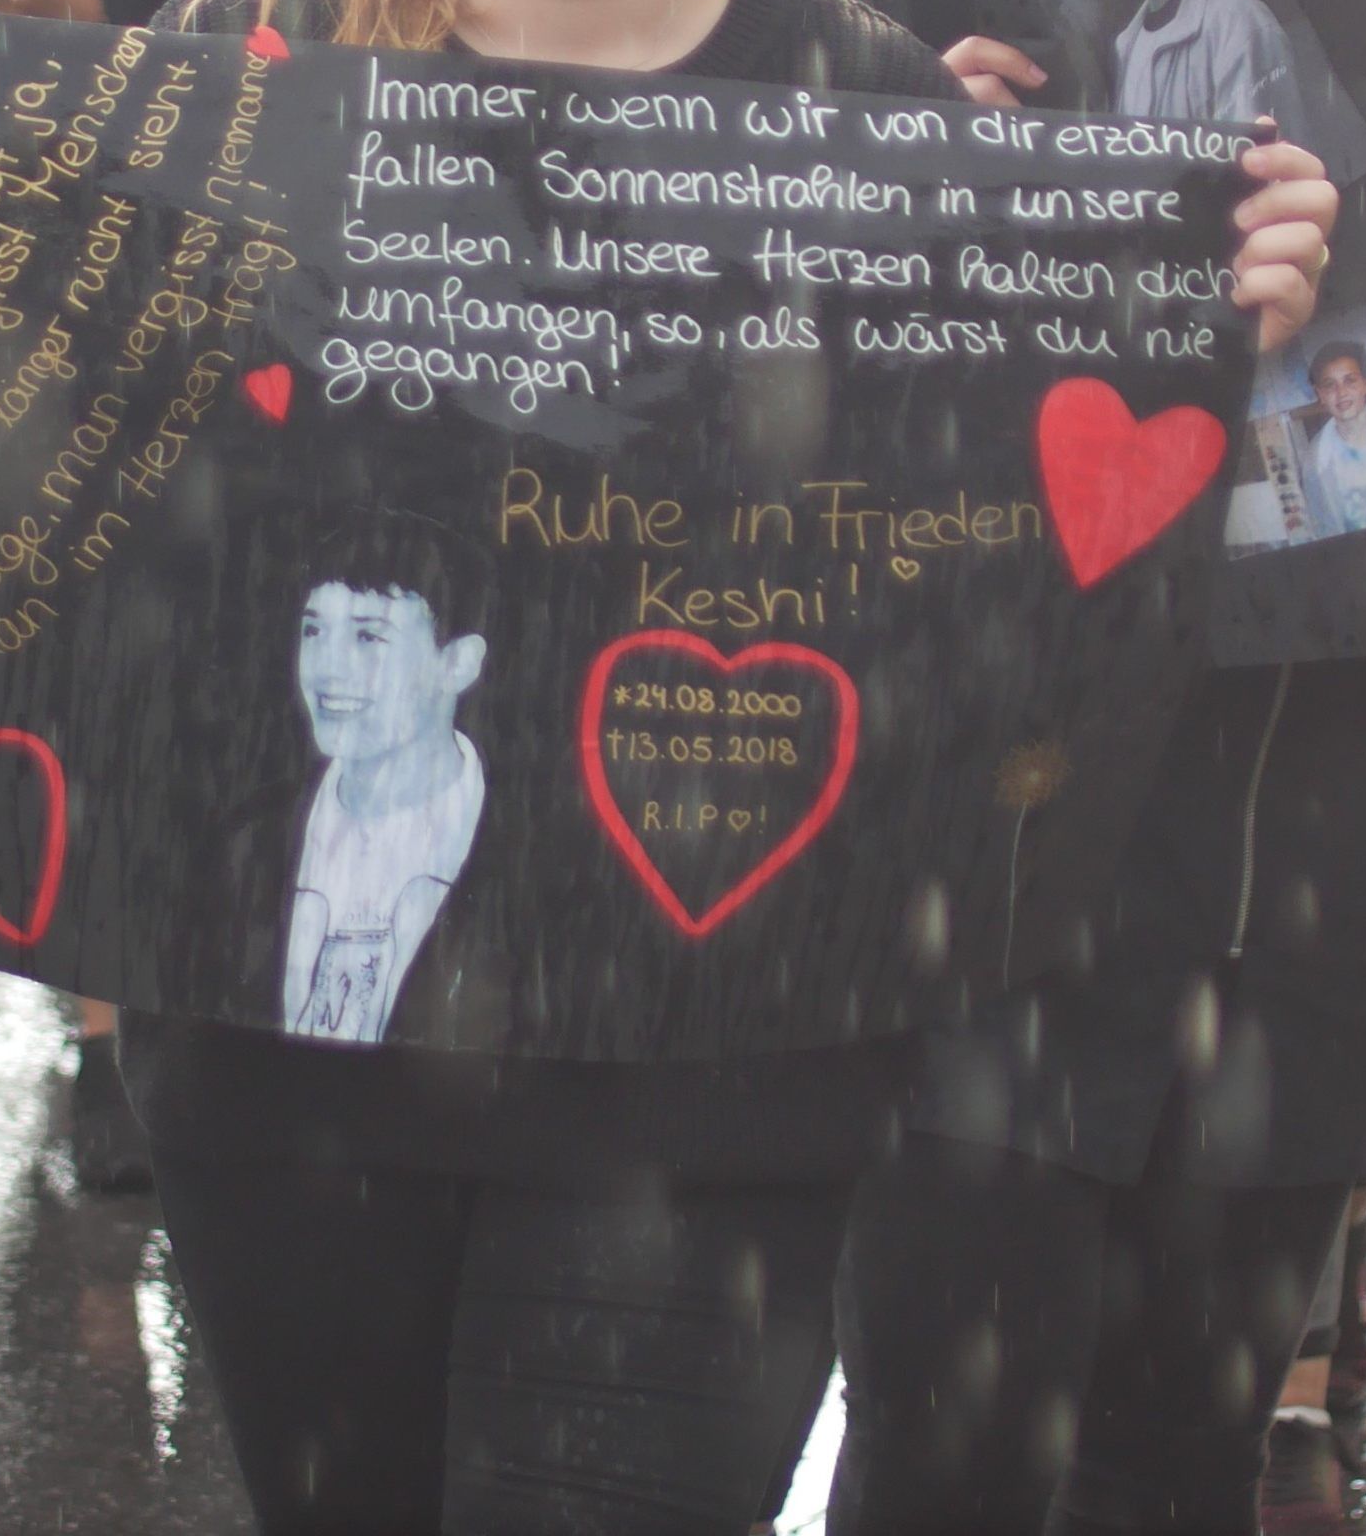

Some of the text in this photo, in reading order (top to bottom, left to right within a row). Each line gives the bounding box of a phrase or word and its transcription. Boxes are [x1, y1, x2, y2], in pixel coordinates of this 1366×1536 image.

[8, 25, 157, 202] Menschen
[564, 84, 719, 131] wenn
[743, 89, 841, 141] wir
[863, 107, 949, 144] von
[971, 105, 1046, 151] dir
[66, 194, 137, 312] nicht
[128, 53, 209, 169] sieht.
[347, 130, 1184, 222] fallen Sonnenstrahlen in unsere
[340, 201, 1239, 300] Seelen. Unsere Herzen halten dich
[41, 391, 130, 507] man
[116, 209, 225, 375] vergisst
[335, 286, 633, 355] umfangen,
[645, 316, 729, 351] so,
[738, 301, 823, 351] als
[1035, 316, 1119, 359] du
[1144, 316, 1217, 360] nie
[320, 336, 627, 415] gegangen!
[72, 510, 131, 572] im
[118, 348, 235, 500] Herzen
[499, 466, 1044, 551] Ruhe in Frieden
